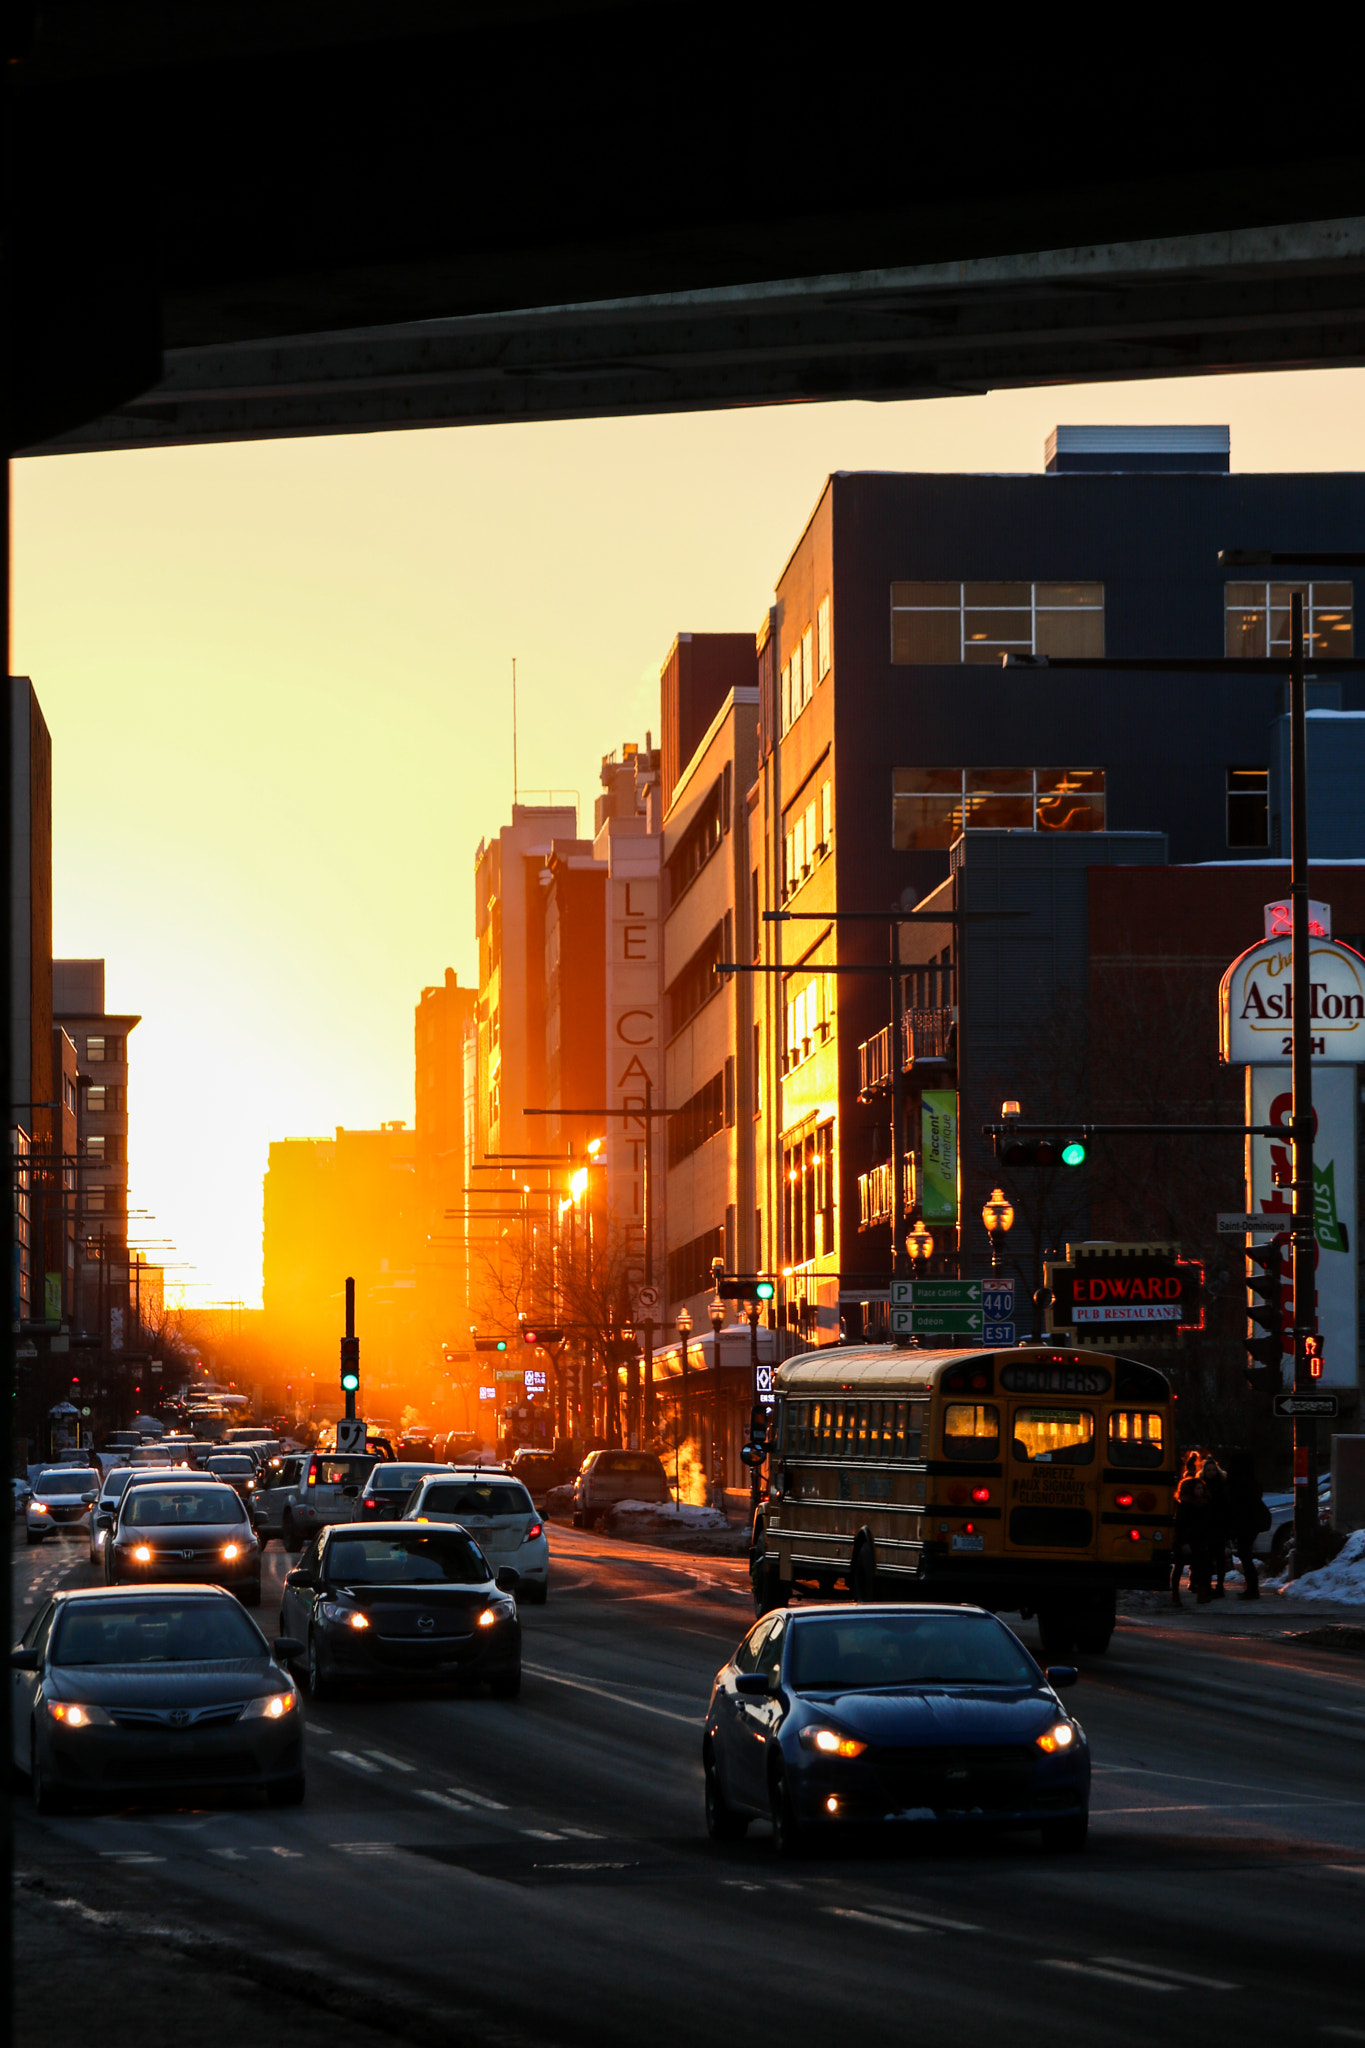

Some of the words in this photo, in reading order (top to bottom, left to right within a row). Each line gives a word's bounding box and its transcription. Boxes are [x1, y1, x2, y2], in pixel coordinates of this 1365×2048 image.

[624, 882, 647, 960] LE
[1266, 952, 1293, 977] Che
[1281, 1037, 1325, 1055] 2H
[929, 1114, 940, 1164] l'accent
[617, 1010, 654, 1296] CARTIER
[1315, 1182, 1338, 1244] PLUS
[1218, 1221, 1285, 1231] Saint-Dominique
[897, 1285, 908, 1301] P
[917, 1289, 936, 1297] Place
[937, 1288, 961, 1297] Cartier
[1072, 1276, 1183, 1301] EDWARD
[983, 1294, 1012, 1311] 440
[897, 1313, 908, 1329] P
[1077, 1309, 1100, 1320] PUB
[985, 1326, 1012, 1340] EST
[1020, 1478, 1040, 1490] AUX
[1043, 1479, 1086, 1493] SIGNAUX
[1020, 1491, 1086, 1506] CLIGNOTANTS
